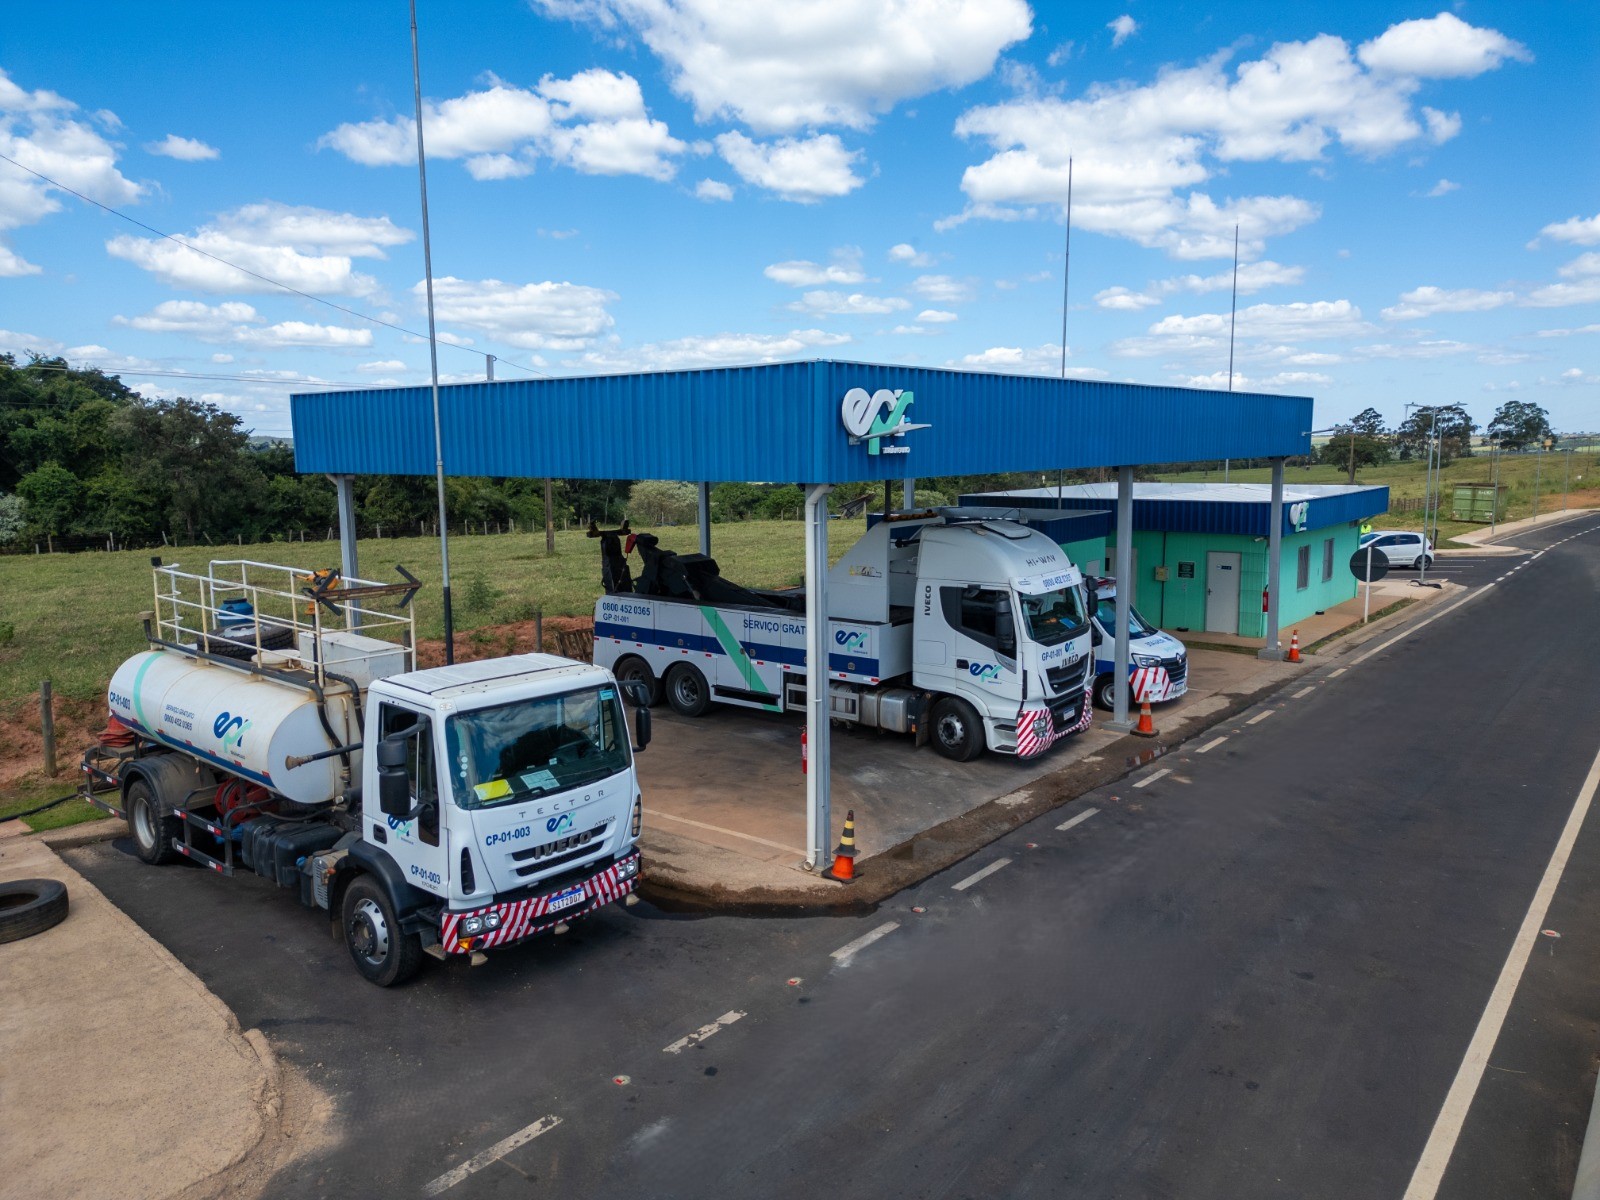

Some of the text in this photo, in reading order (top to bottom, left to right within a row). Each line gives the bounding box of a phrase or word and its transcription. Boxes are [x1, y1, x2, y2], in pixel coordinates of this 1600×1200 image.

[603, 603, 651, 616] 0800 452 0365
[744, 620, 806, 635] SERVIÇO GRAT
[1063, 654, 1079, 667] IVECO
[518, 789, 605, 819] TECTOR
[595, 815, 617, 828] ATTACK
[486, 826, 531, 847] CP-01-003
[534, 830, 593, 861] IVECO
[411, 865, 441, 885] CP-01-003
